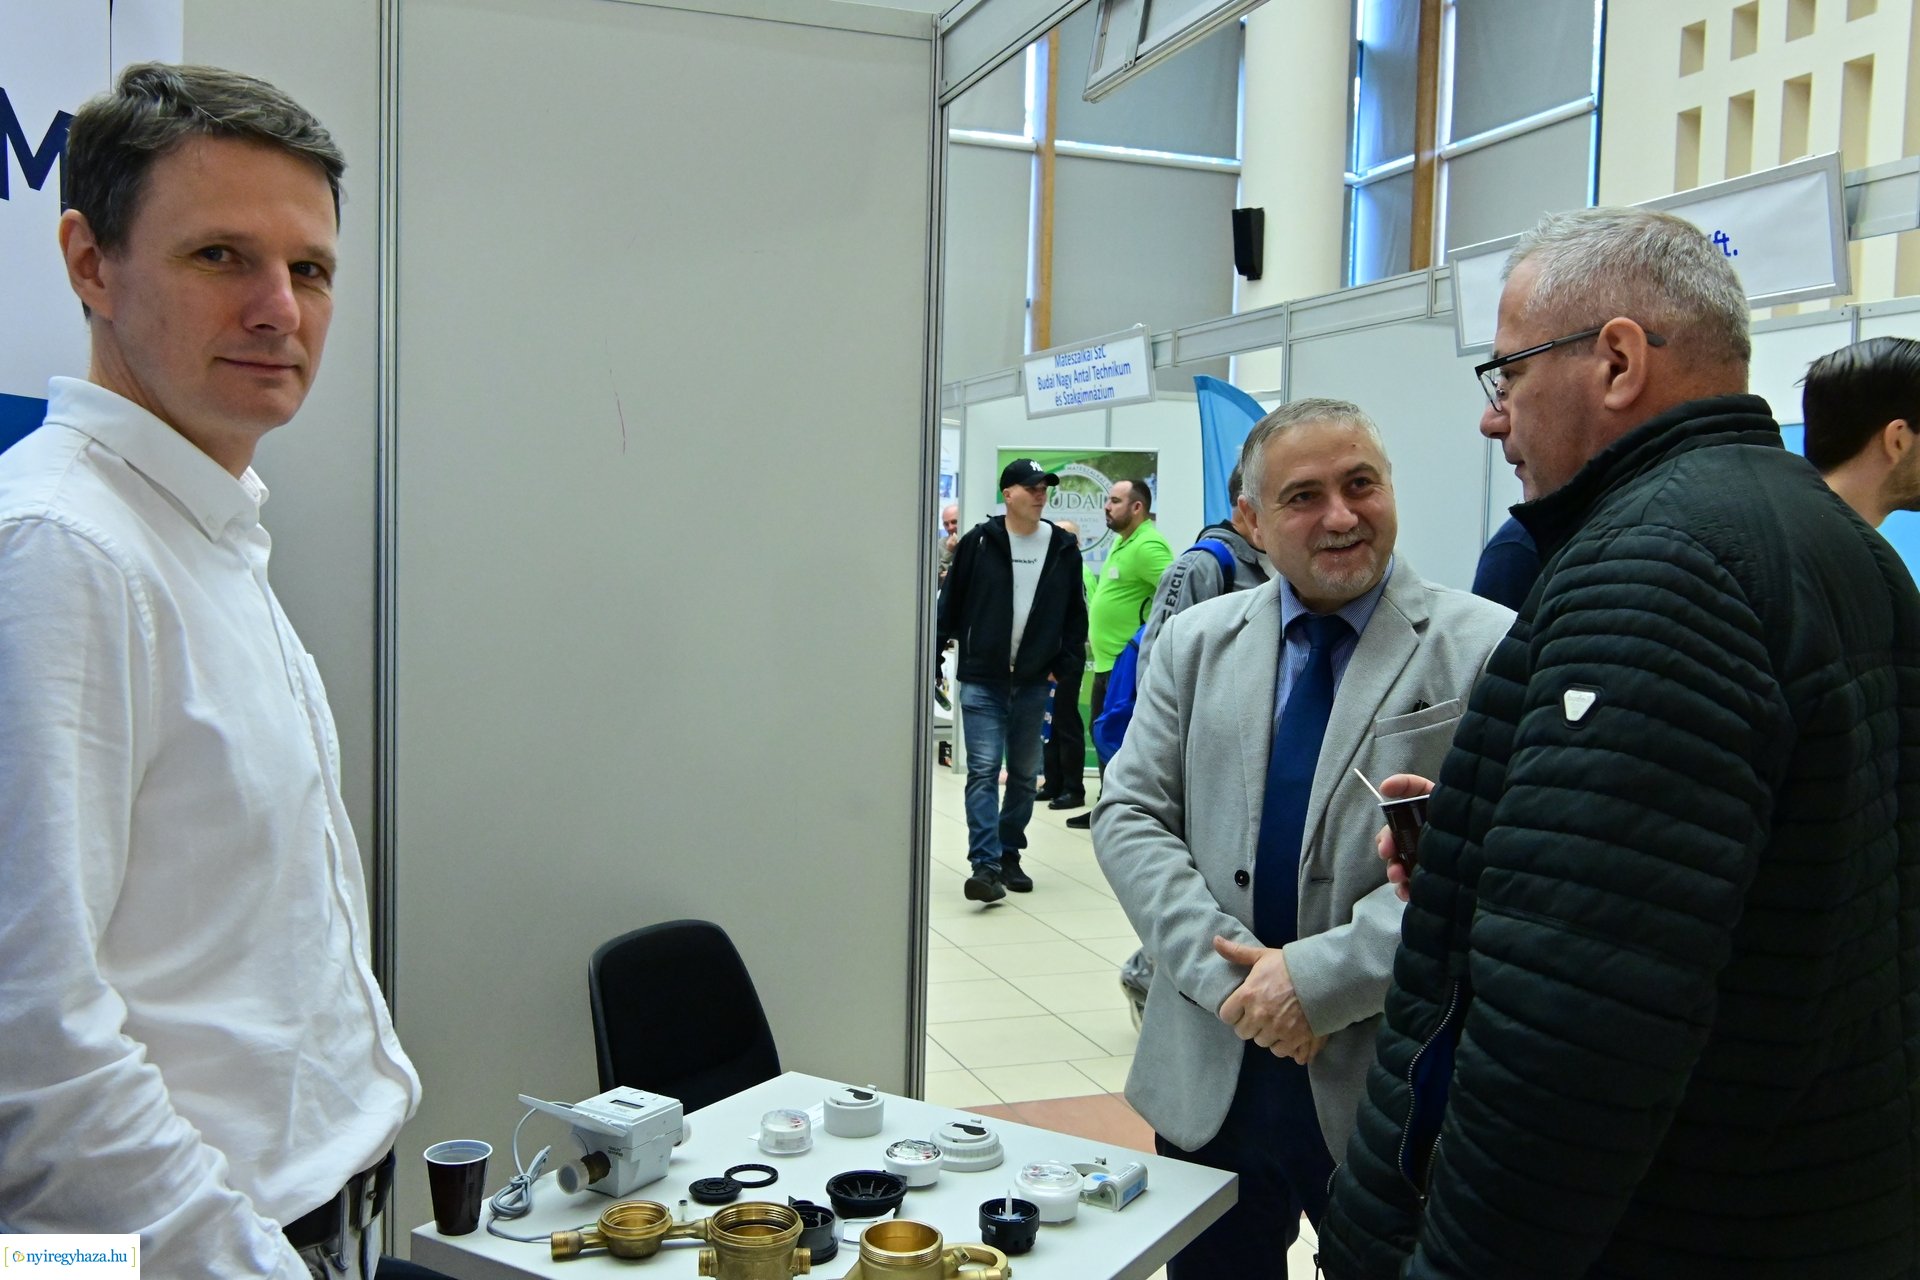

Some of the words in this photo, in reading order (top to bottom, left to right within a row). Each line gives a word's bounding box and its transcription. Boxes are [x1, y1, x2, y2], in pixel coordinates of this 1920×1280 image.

[1707, 230, 1738, 257] ft.
[1094, 344, 1107, 360] SzC
[1037, 374, 1055, 391] Budai
[1056, 372, 1072, 389] Nagy
[1073, 366, 1091, 383] Antal
[1092, 361, 1132, 380] Technikum
[1049, 493, 1103, 509] UDAI
